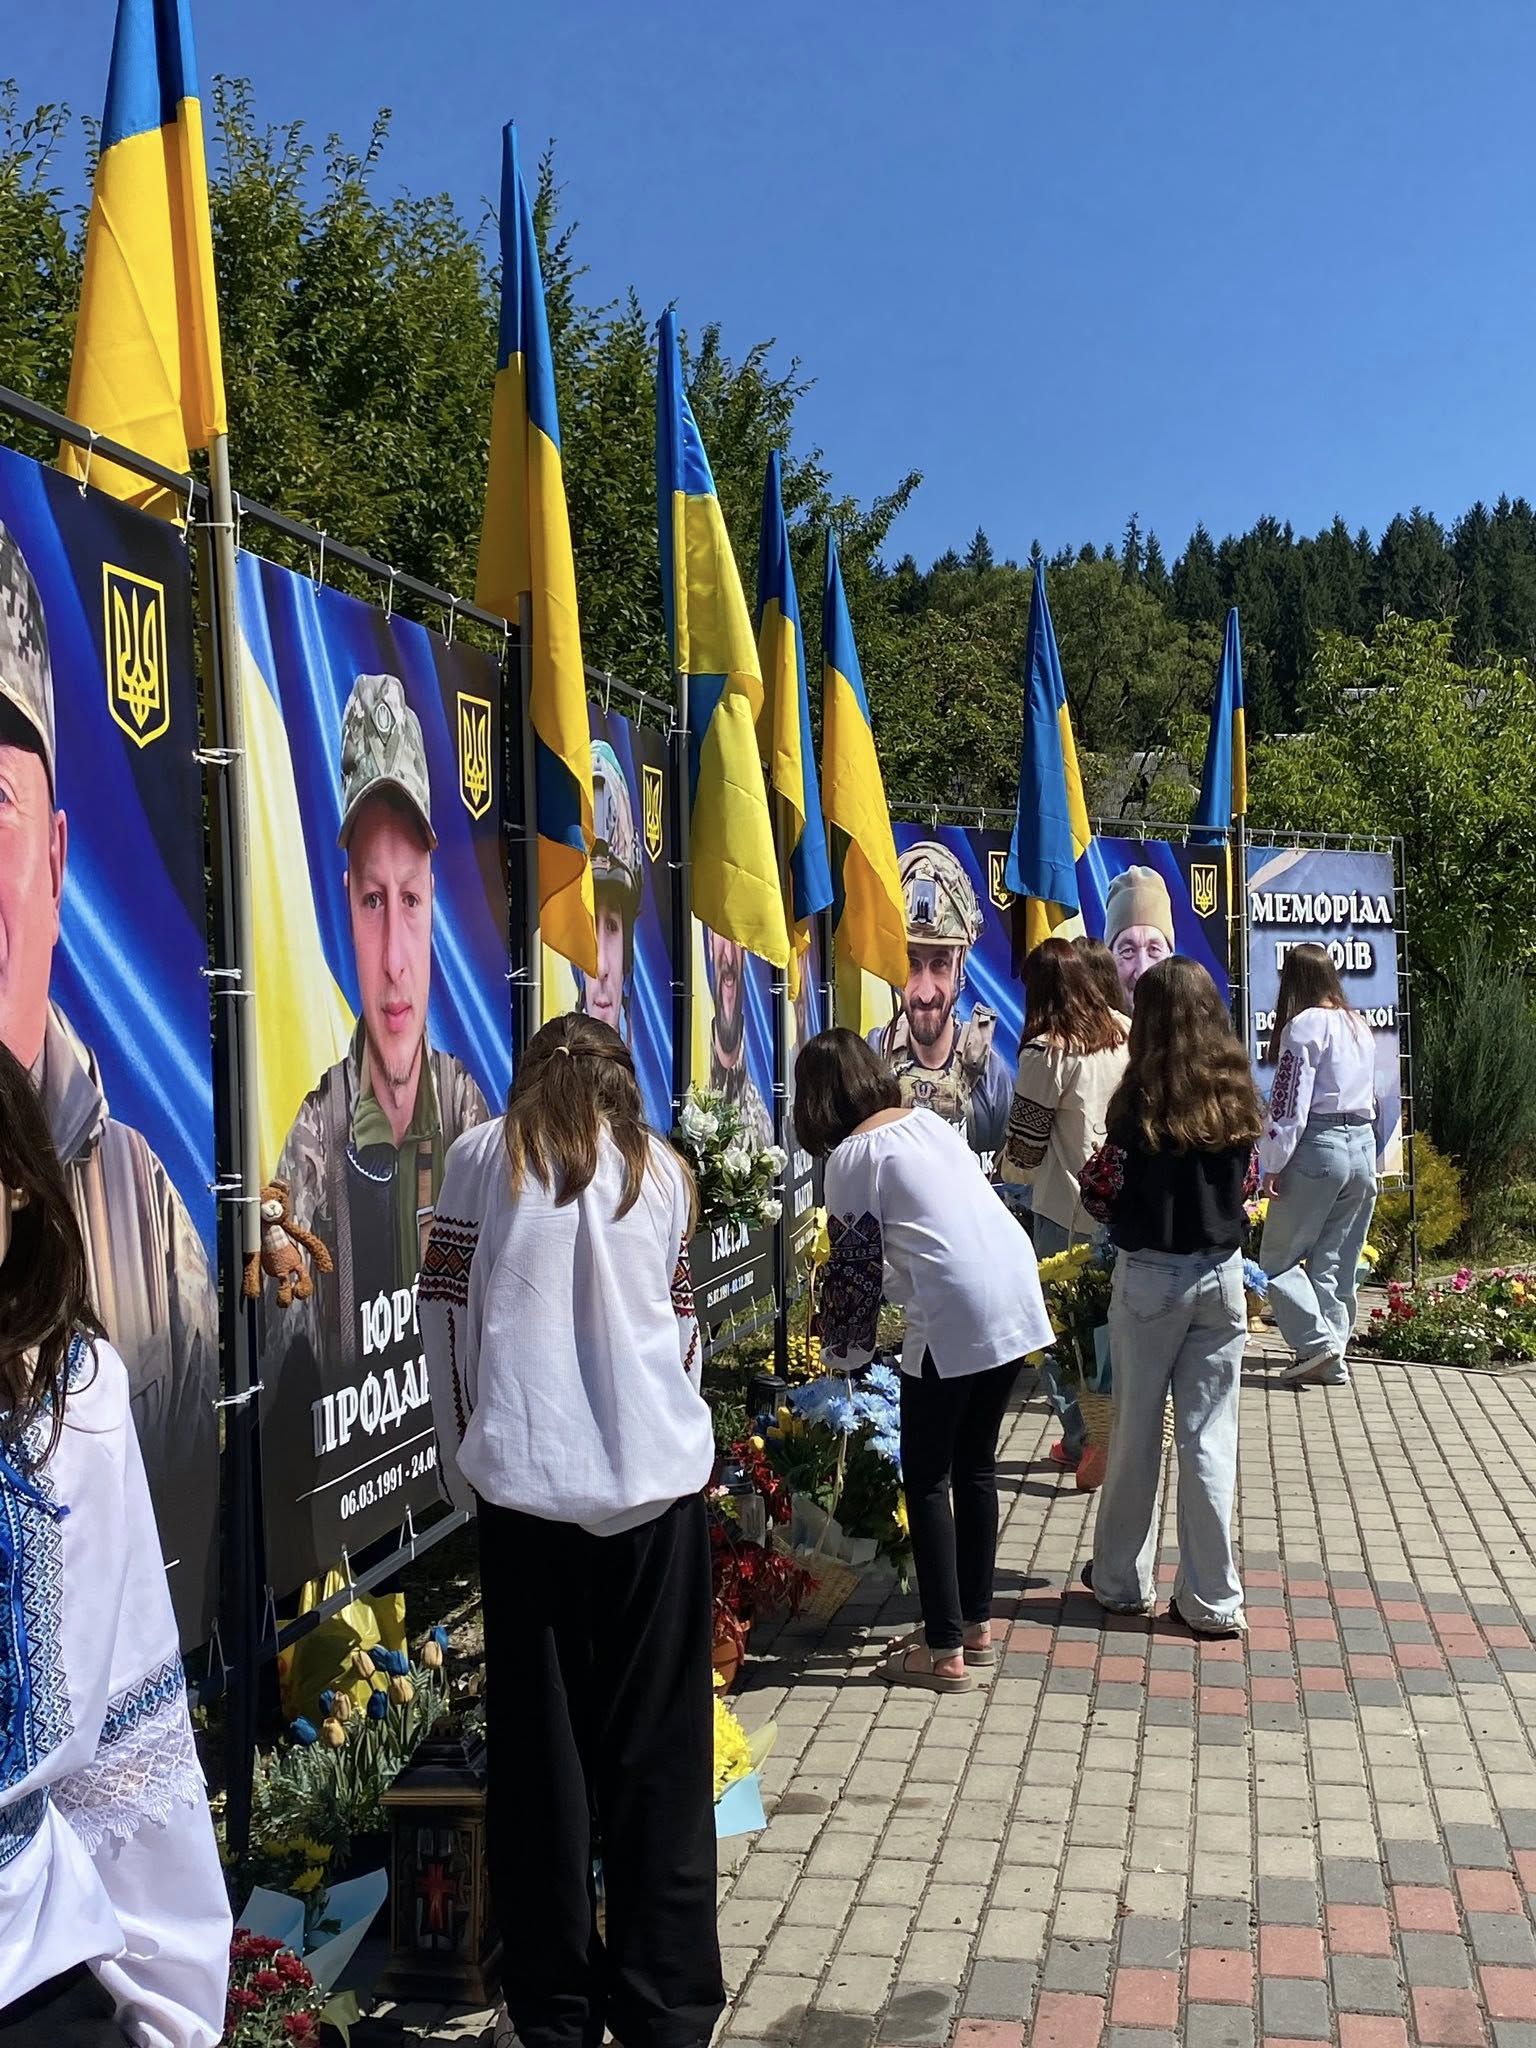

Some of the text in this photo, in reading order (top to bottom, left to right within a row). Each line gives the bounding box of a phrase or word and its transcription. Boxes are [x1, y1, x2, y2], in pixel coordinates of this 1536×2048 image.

[1251, 890, 1393, 925] МЕМОРІАЛ
[1275, 937, 1372, 970] ГОЇВ
[360, 1272, 420, 1355] ЮРІ
[340, 1463, 403, 1520] 06.03.1991
